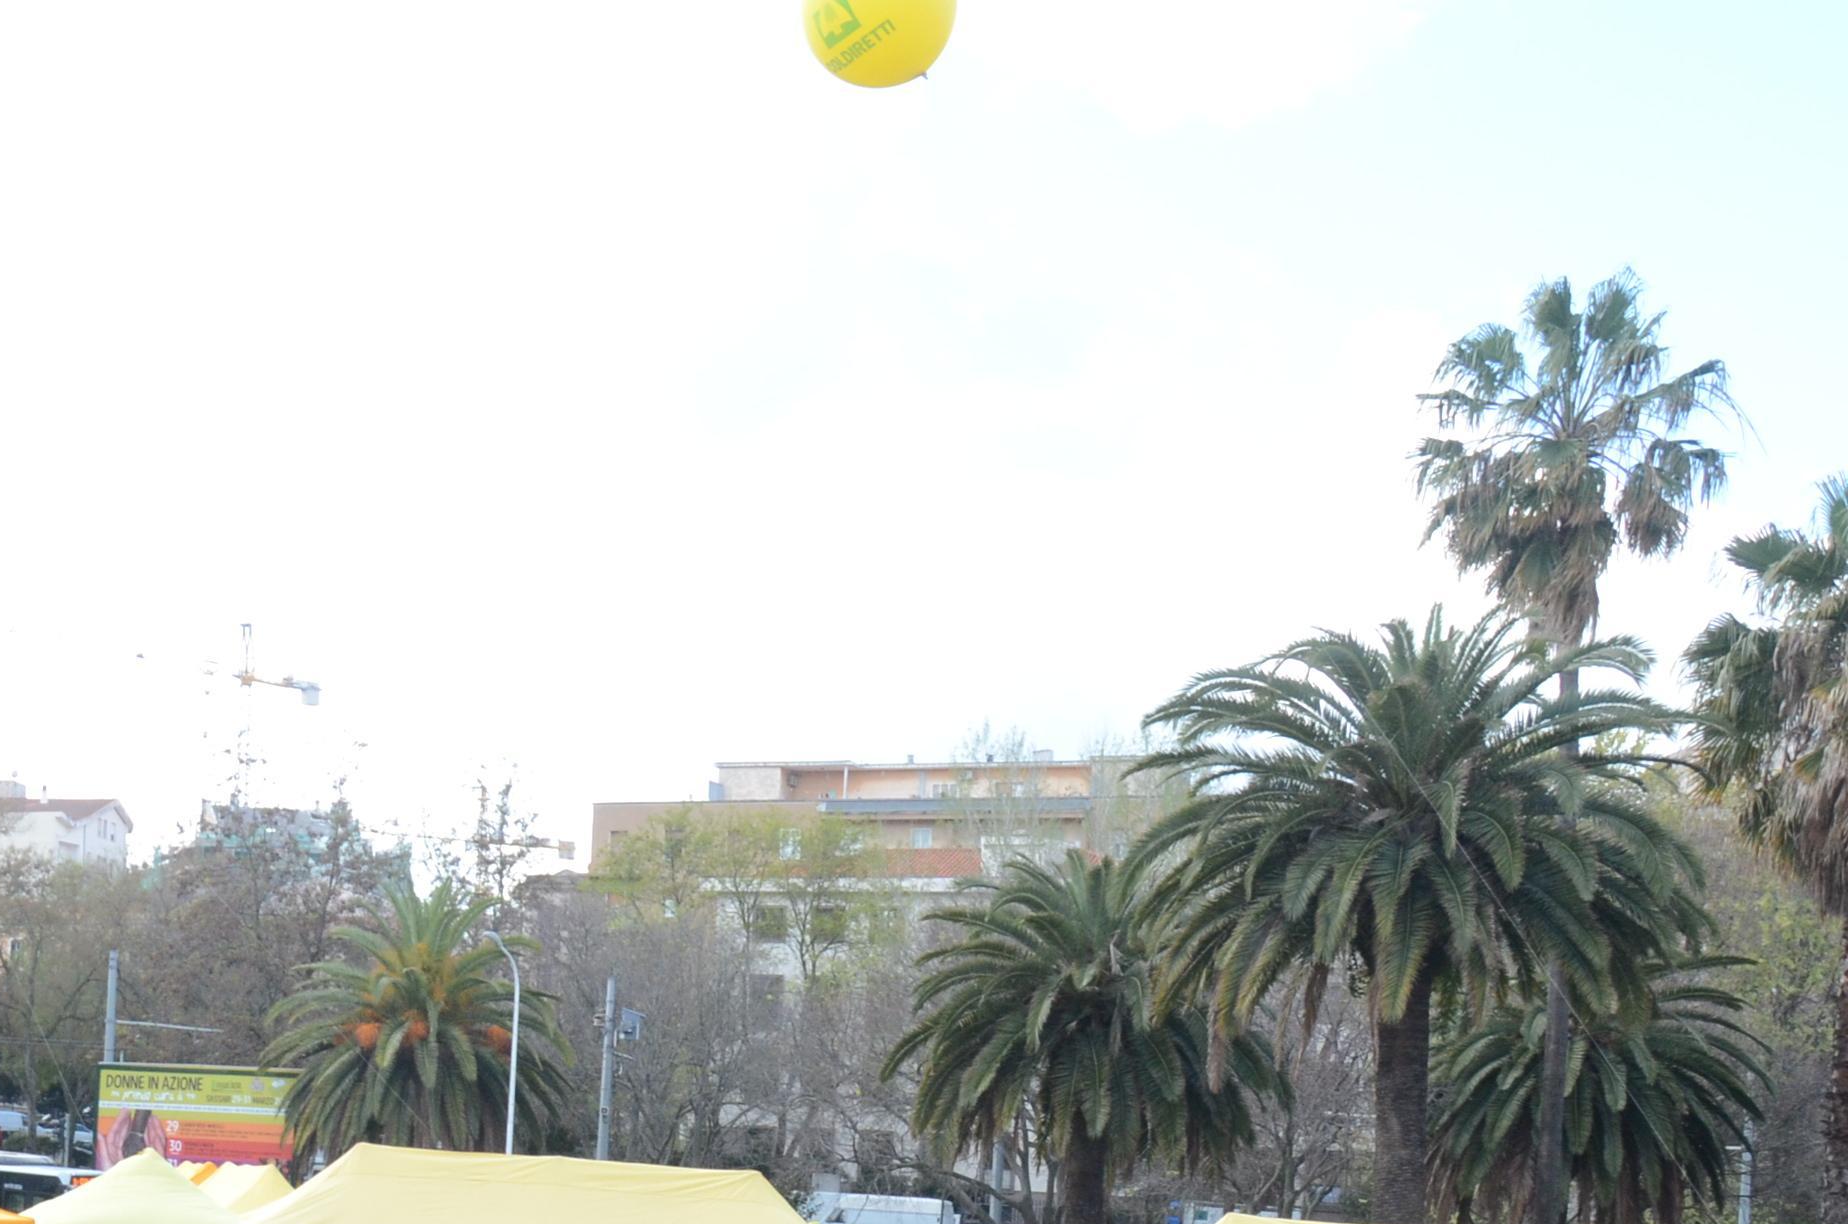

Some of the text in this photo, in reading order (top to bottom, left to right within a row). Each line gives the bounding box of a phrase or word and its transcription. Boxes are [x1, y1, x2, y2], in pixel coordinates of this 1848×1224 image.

[106, 1074, 144, 1089] DONNE
[148, 1076, 160, 1090] IN
[161, 1076, 203, 1092] AZIONE
[170, 1140, 182, 1151] 30
